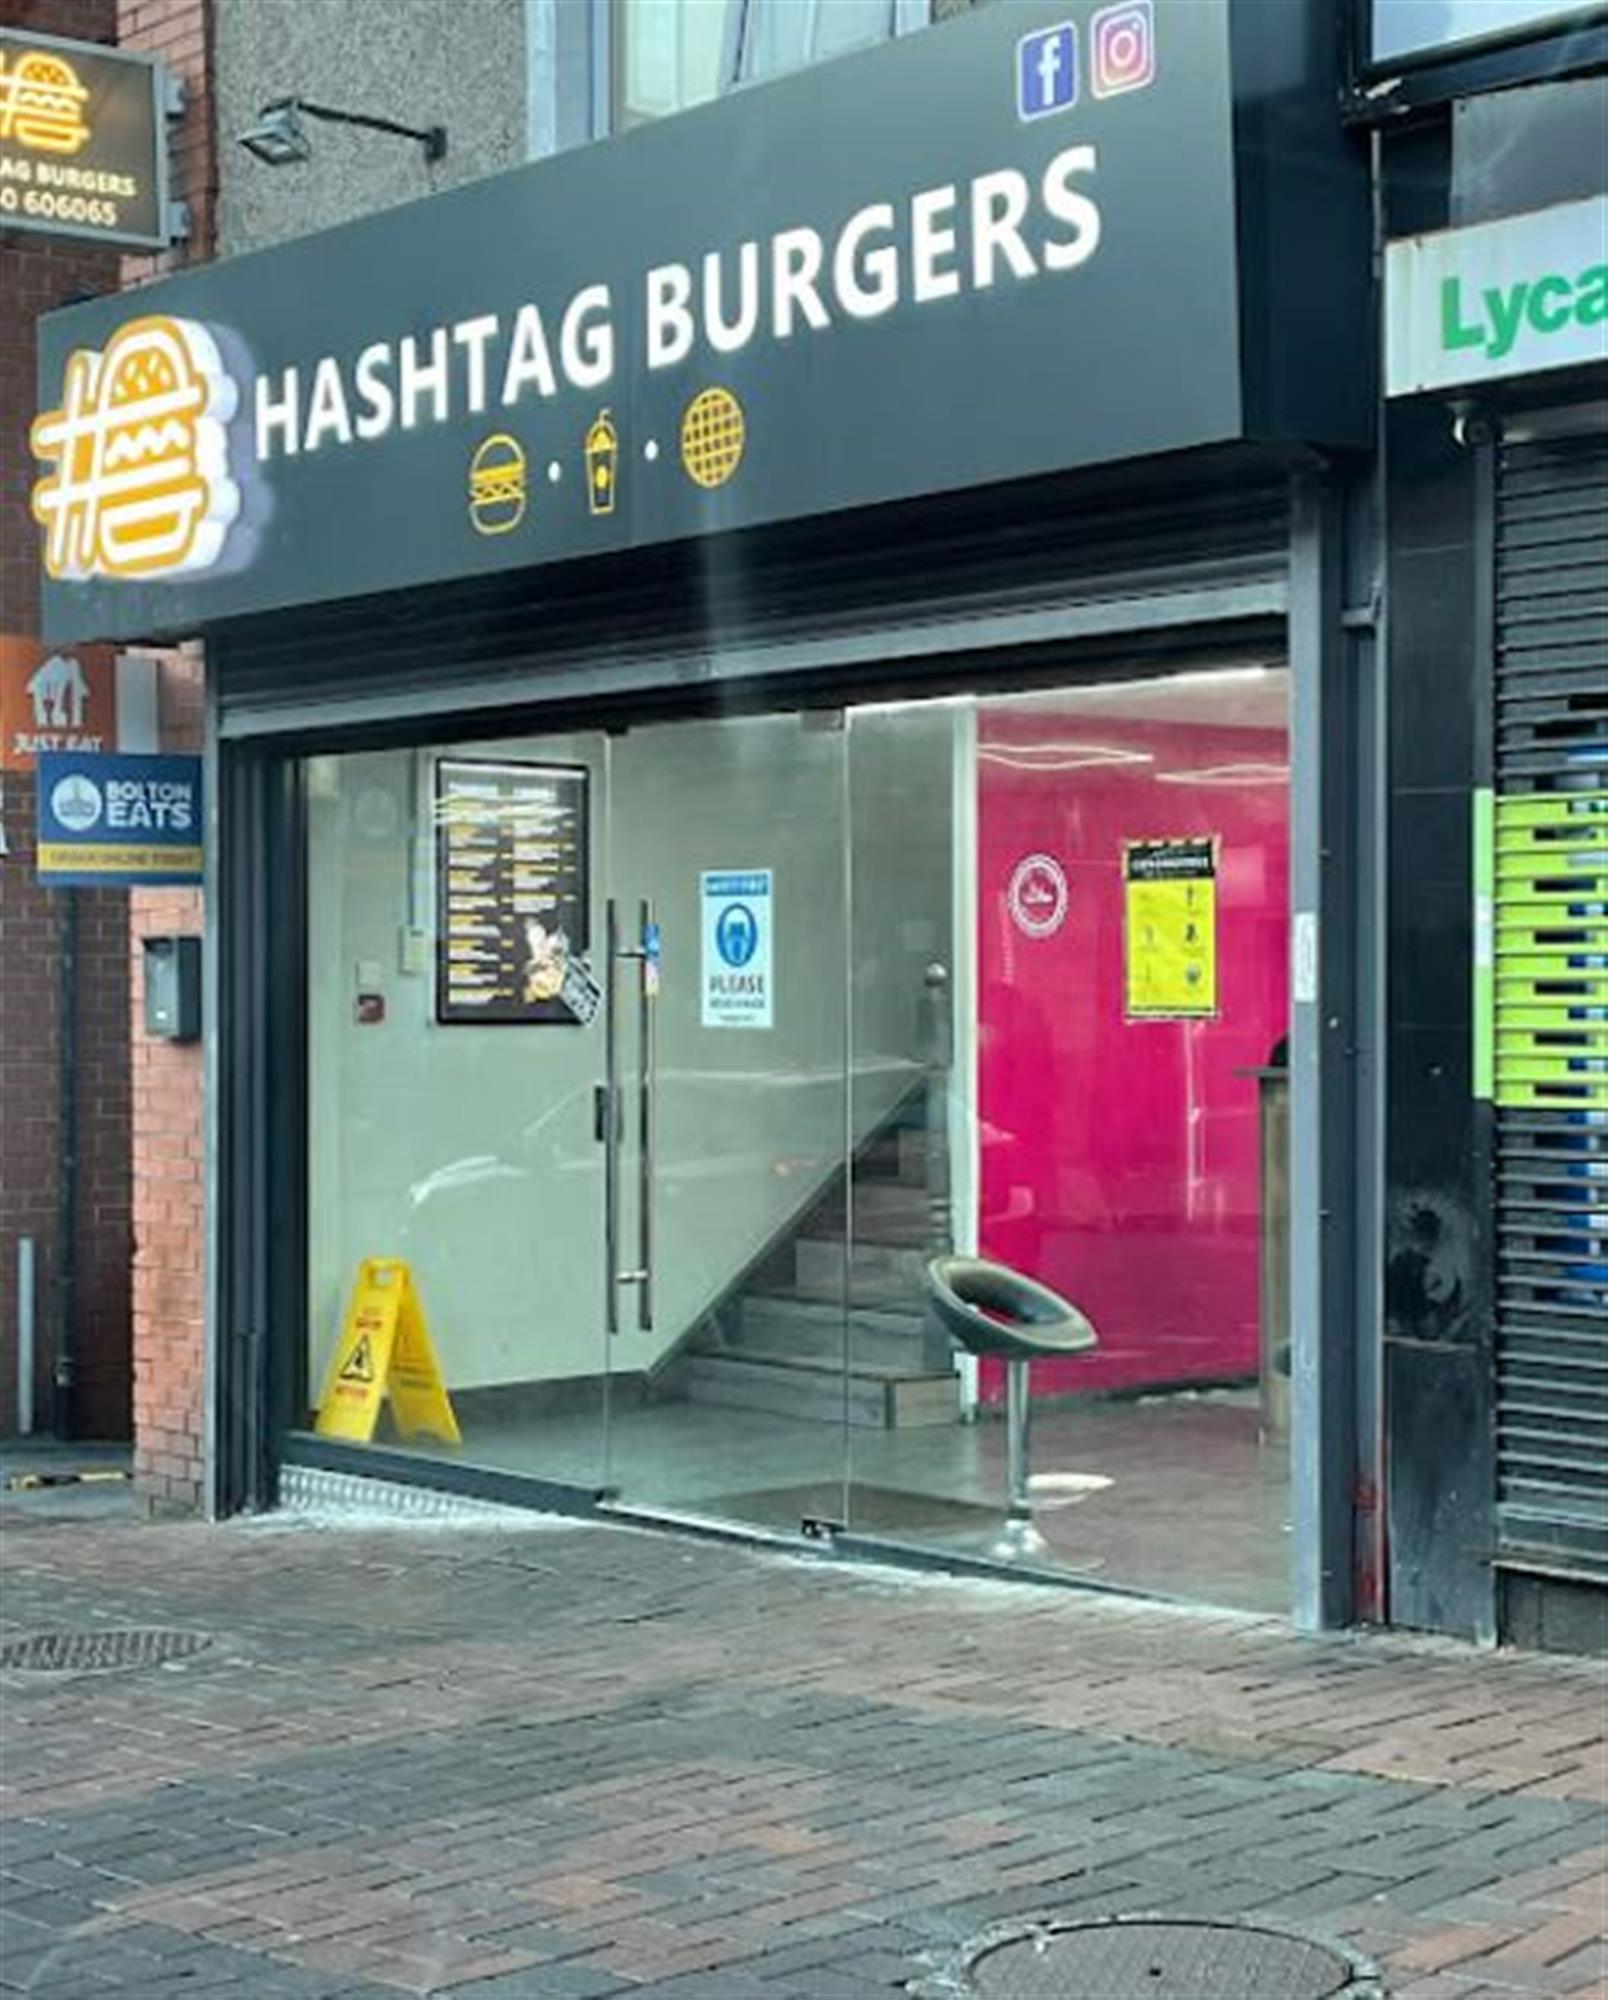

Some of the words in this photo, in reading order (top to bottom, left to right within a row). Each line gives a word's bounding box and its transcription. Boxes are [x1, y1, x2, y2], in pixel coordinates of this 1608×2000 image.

[36, 161, 137, 196] BURGERS
[23, 189, 117, 227] 606065
[255, 284, 615, 462] HASHTAG
[646, 144, 1102, 369] BURGERS
[1442, 265, 1608, 360] Lyca
[13, 733, 59, 755] JUST
[65, 734, 103, 753] EAT
[105, 780, 193, 801] BOLTON
[106, 802, 192, 828] EATS
[709, 974, 764, 995] PLEASE
